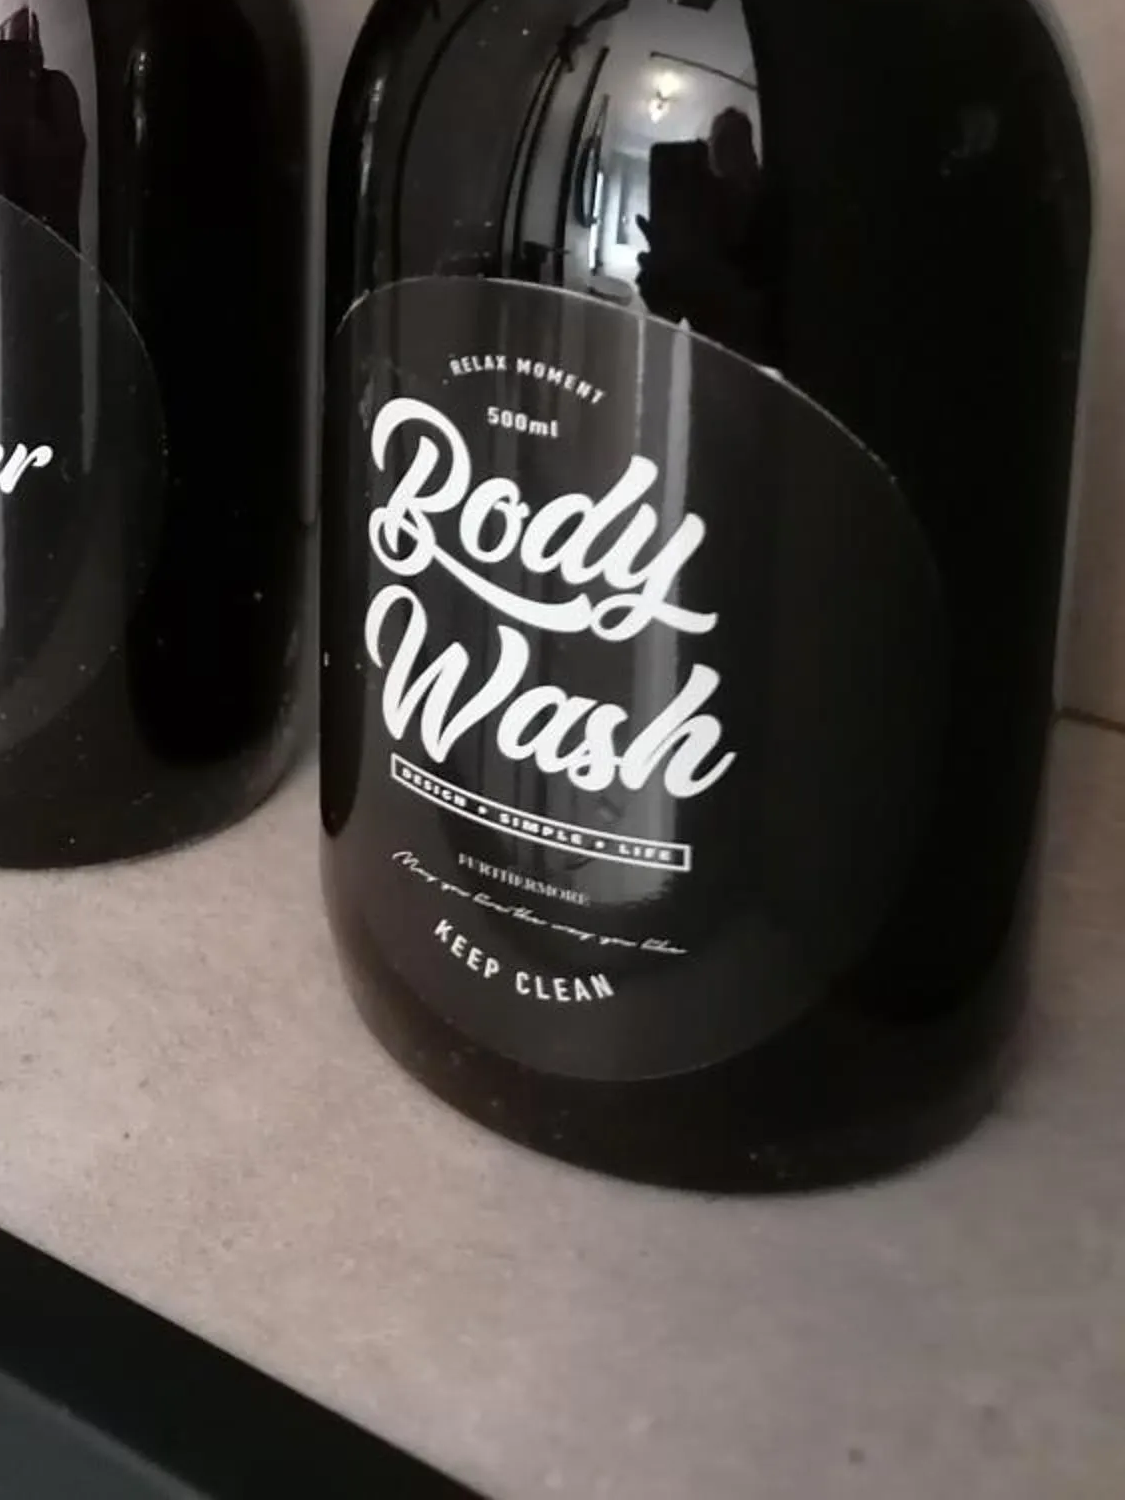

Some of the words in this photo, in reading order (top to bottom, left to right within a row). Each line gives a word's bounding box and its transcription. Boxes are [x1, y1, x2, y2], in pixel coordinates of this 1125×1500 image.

[449, 355, 508, 376] RELAX
[515, 357, 608, 405] MOMENT
[487, 405, 559, 439] 500ml
[368, 397, 719, 642] Body
[365, 584, 737, 798] Wash
[401, 766, 467, 808] DESIGN
[499, 811, 584, 845] SIMPLE
[618, 843, 672, 862] LIFE
[434, 918, 500, 979] KEEP
[516, 972, 614, 1002] CLEAN
